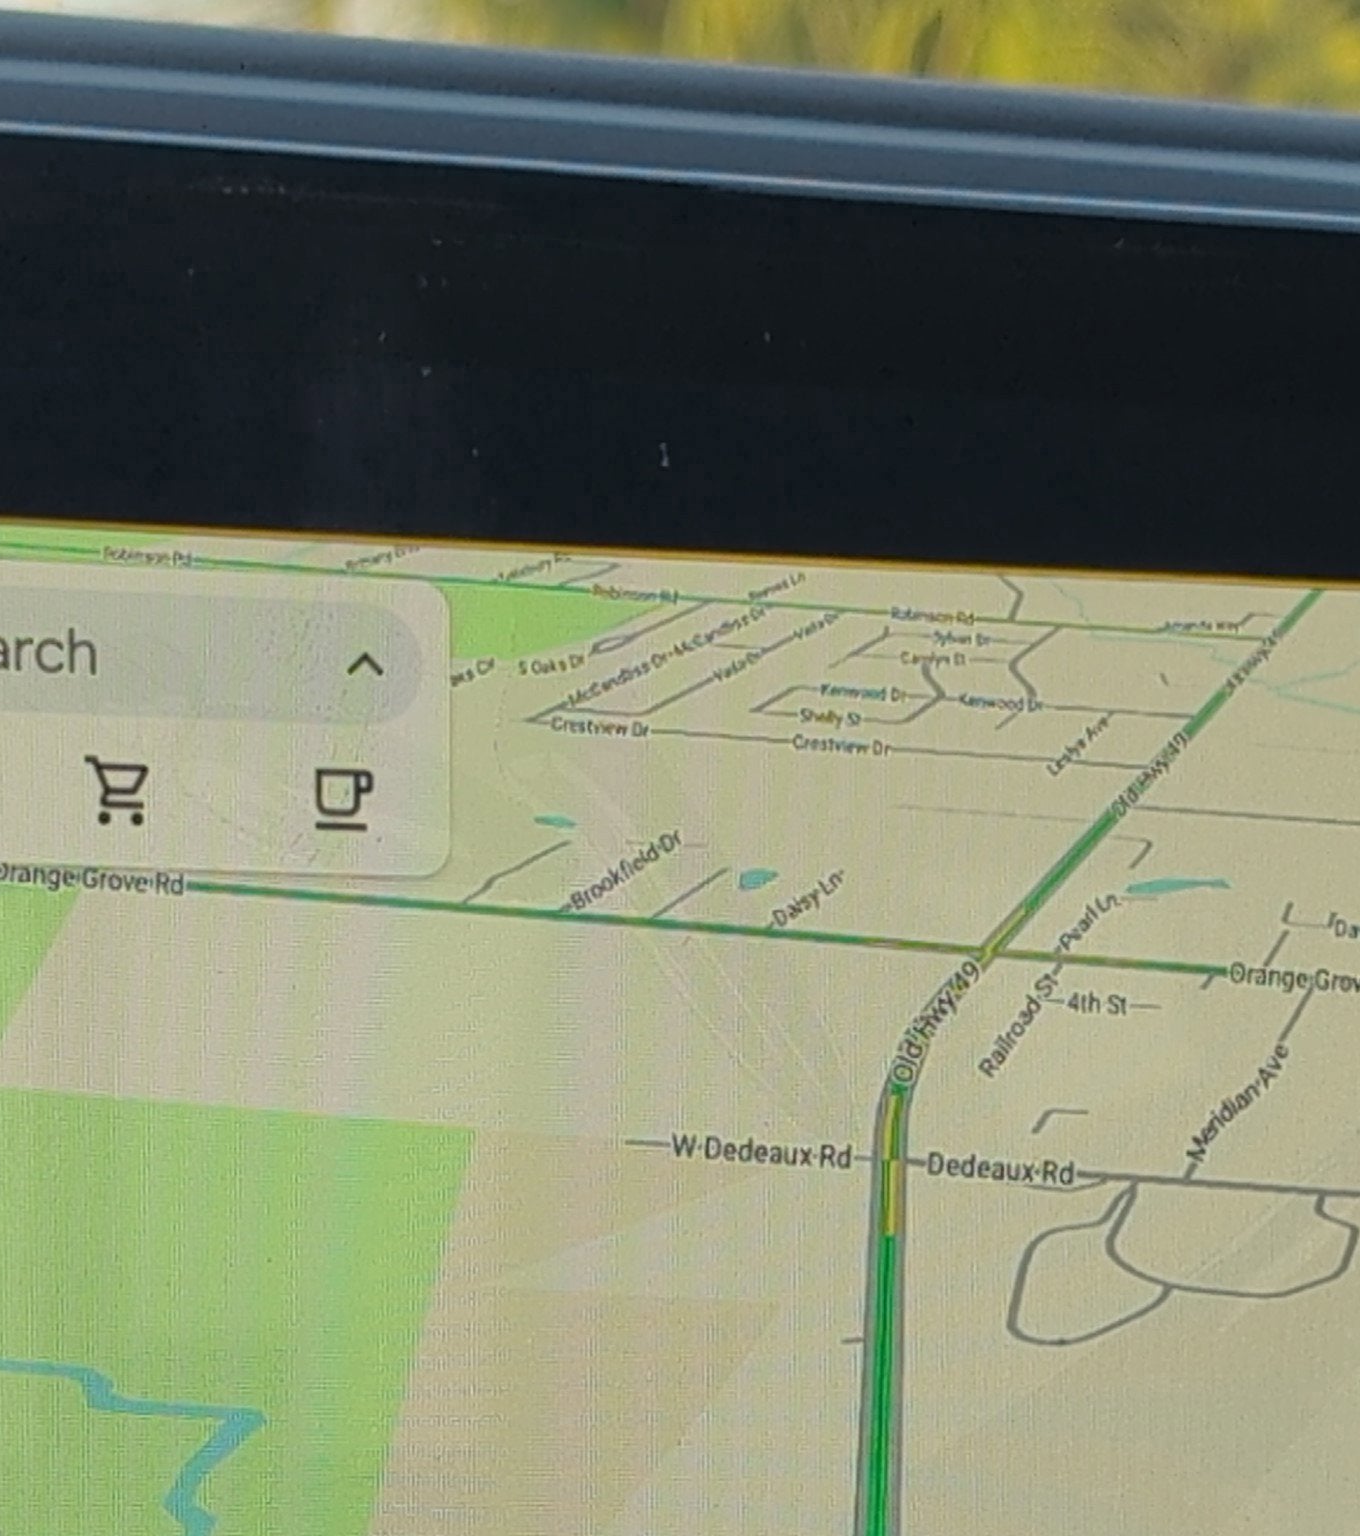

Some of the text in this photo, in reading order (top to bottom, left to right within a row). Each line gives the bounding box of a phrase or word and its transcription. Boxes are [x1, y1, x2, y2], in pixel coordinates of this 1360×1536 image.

[956, 613, 974, 626] Rd
[82, 868, 149, 893] Grove
[155, 871, 185, 895] Rd
[570, 829, 682, 910] Brookfield Dr
[772, 873, 842, 928] Daisy Ln
[1059, 906, 1098, 951] Pearl
[1230, 962, 1314, 992] Orange
[894, 1038, 924, 1083] Old
[950, 960, 979, 998] 49
[1067, 992, 1127, 1015] 4th St
[978, 971, 1058, 1077] Railroad St
[1186, 1043, 1289, 1162] Meridian Ave
[672, 1134, 851, 1170] W Dedeaux Rd
[927, 1152, 1075, 1185] Dedeaux Rd
